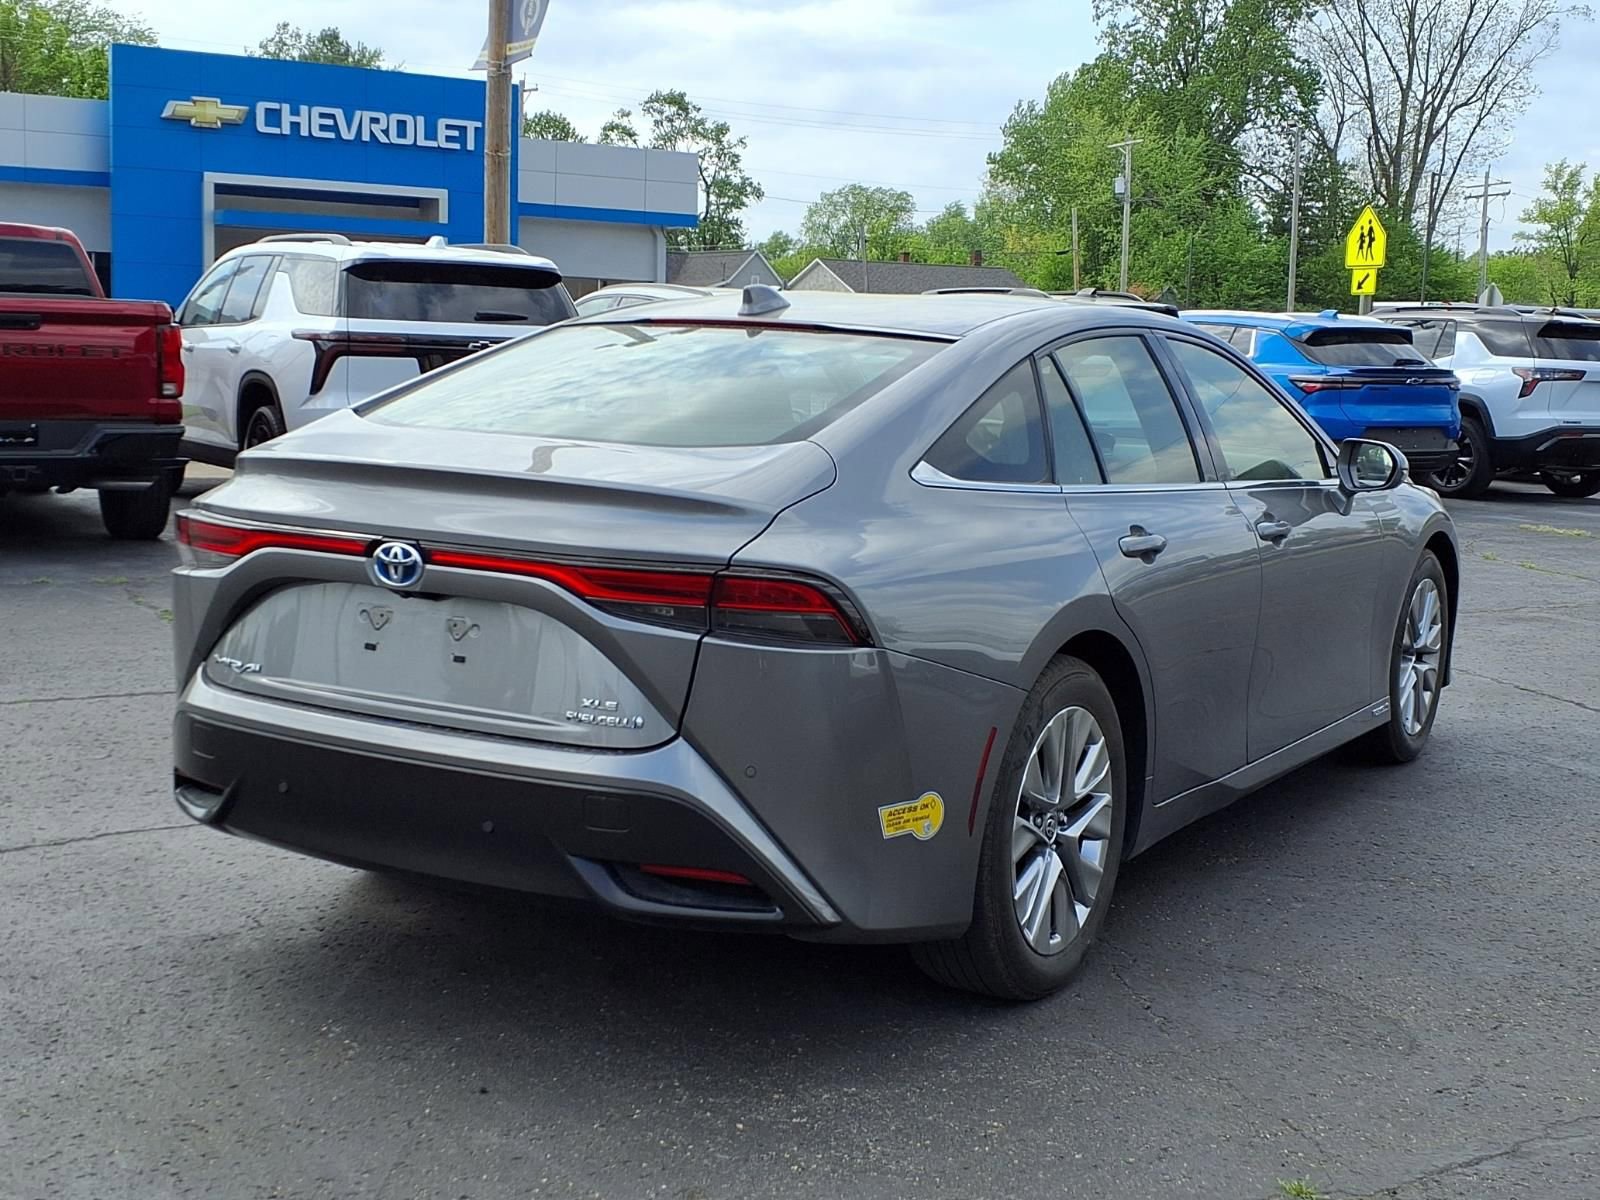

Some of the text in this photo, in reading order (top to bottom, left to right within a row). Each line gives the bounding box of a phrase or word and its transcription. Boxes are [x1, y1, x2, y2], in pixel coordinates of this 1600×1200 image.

[255, 101, 483, 150] CHEVROLET
[581, 698, 618, 711] XLE
[887, 803, 930, 817] ACCESS OK
